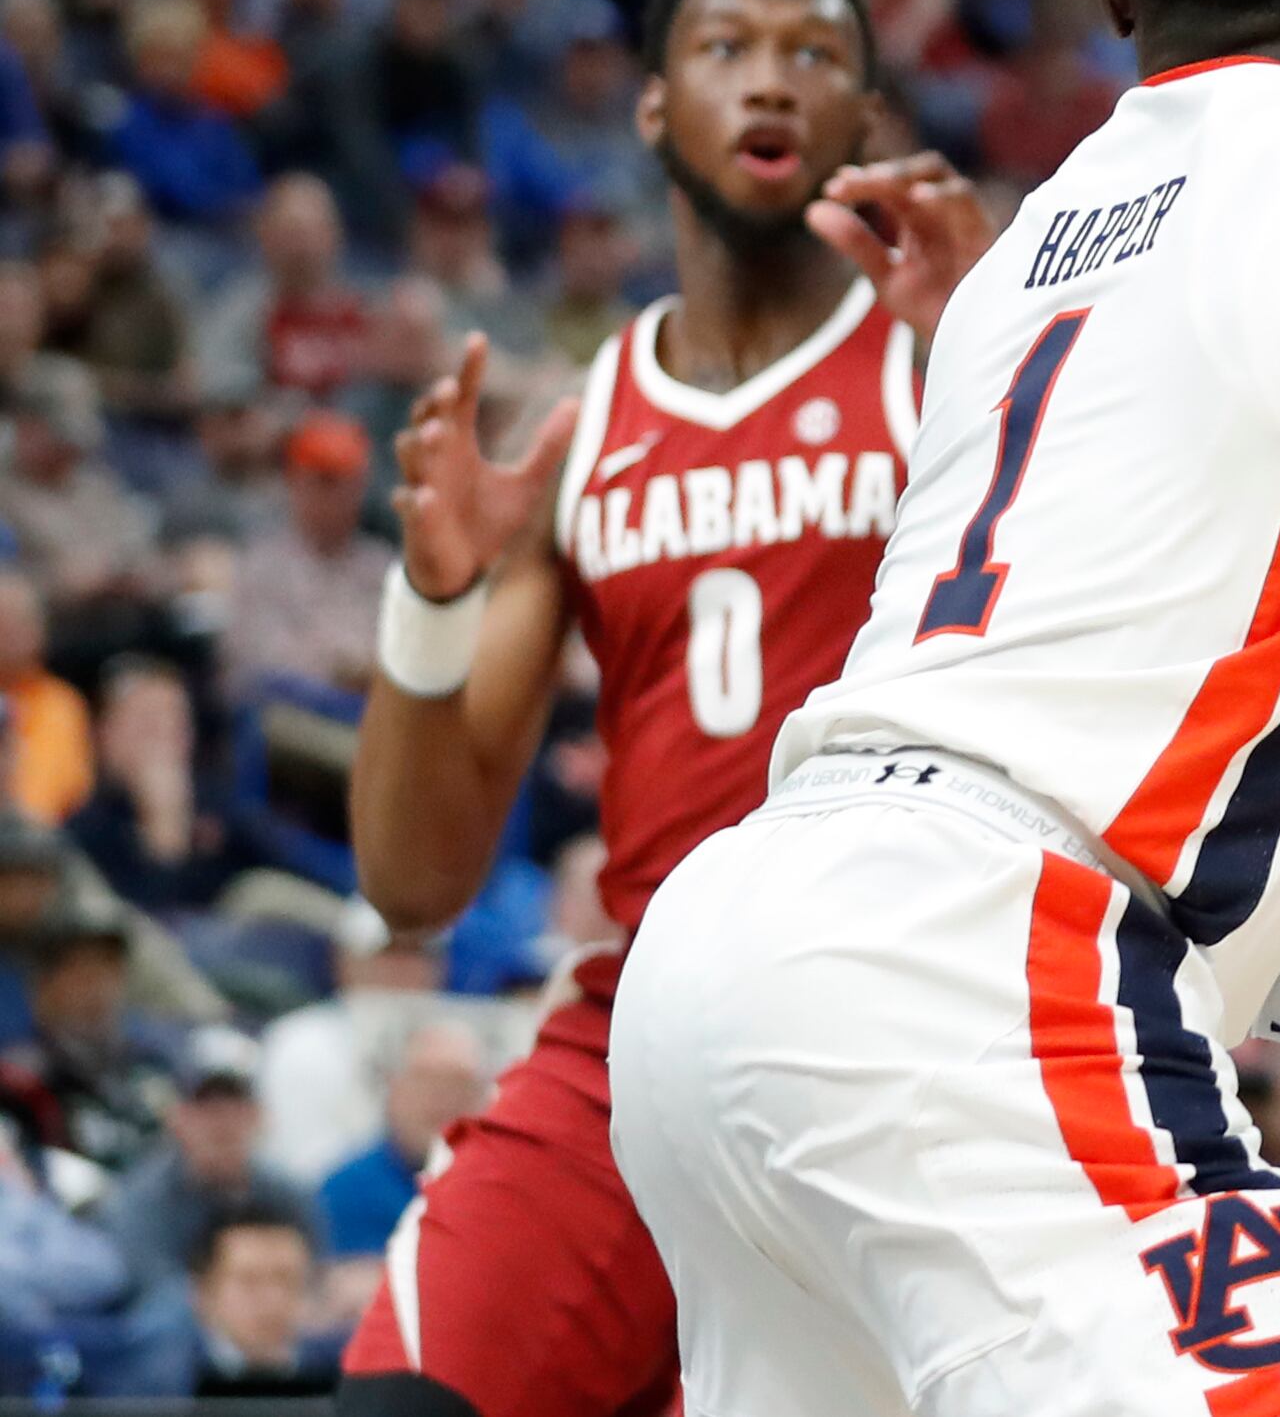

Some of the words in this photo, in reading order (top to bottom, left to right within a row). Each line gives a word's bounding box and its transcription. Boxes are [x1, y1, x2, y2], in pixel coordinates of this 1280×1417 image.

[1024, 175, 1188, 289] HARPER
[911, 304, 1095, 647] 1
[685, 566, 764, 738] 0
